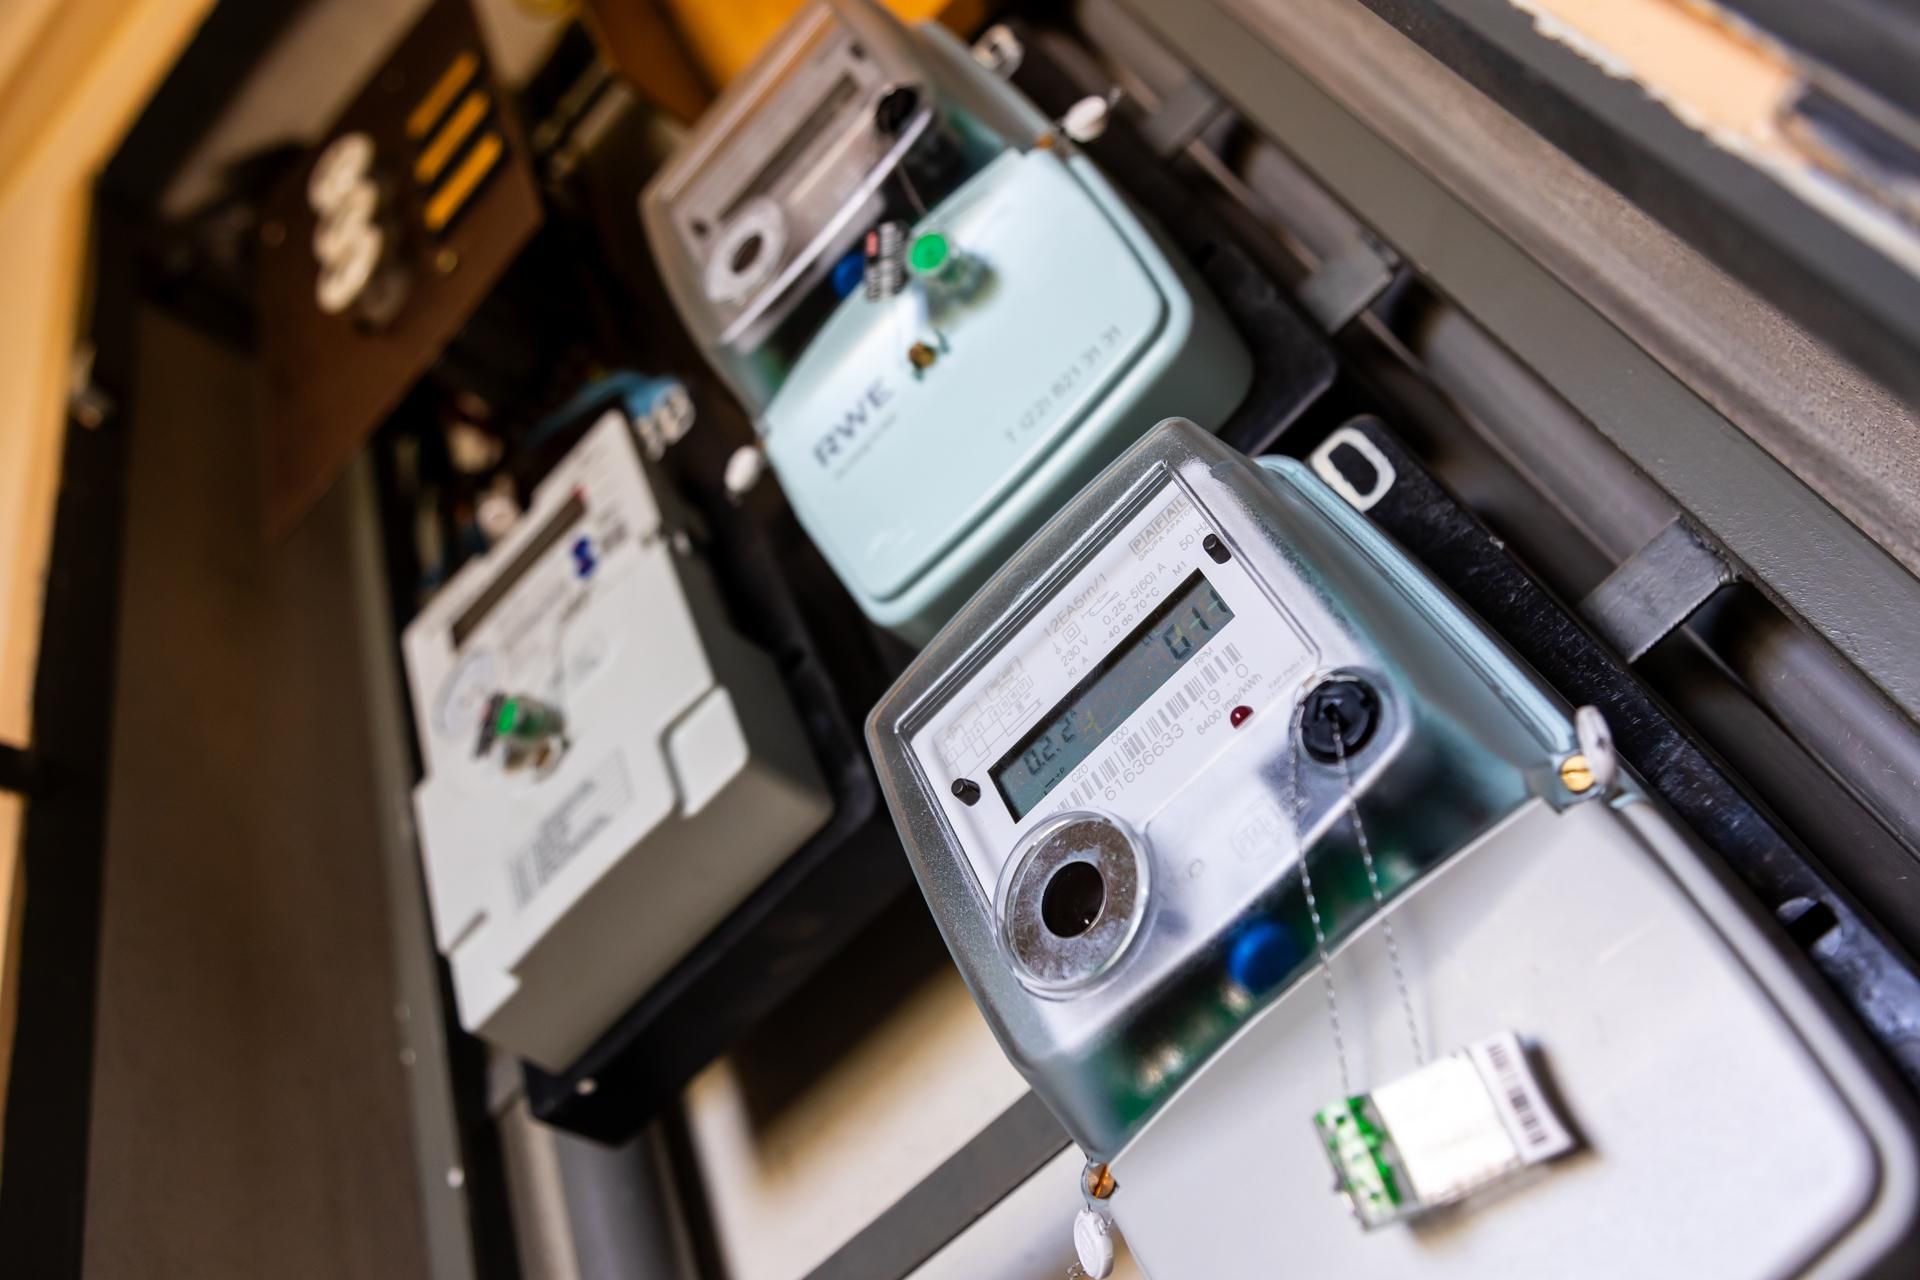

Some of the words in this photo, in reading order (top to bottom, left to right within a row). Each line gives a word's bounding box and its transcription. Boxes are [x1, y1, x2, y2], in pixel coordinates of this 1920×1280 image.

[813, 376, 893, 467] RWE
[1132, 499, 1187, 551] PAFAL
[1061, 644, 1080, 667] 230
[1080, 635, 1088, 646] V
[1157, 563, 1166, 574] A
[1178, 534, 1195, 551] 50
[1121, 614, 1134, 626] do
[1172, 561, 1186, 576] M1
[1196, 709, 1222, 735] 6400
[1221, 673, 1263, 712] imp/kWh
[1104, 723, 1184, 801] 61636633
[1199, 689, 1221, 711] 19
